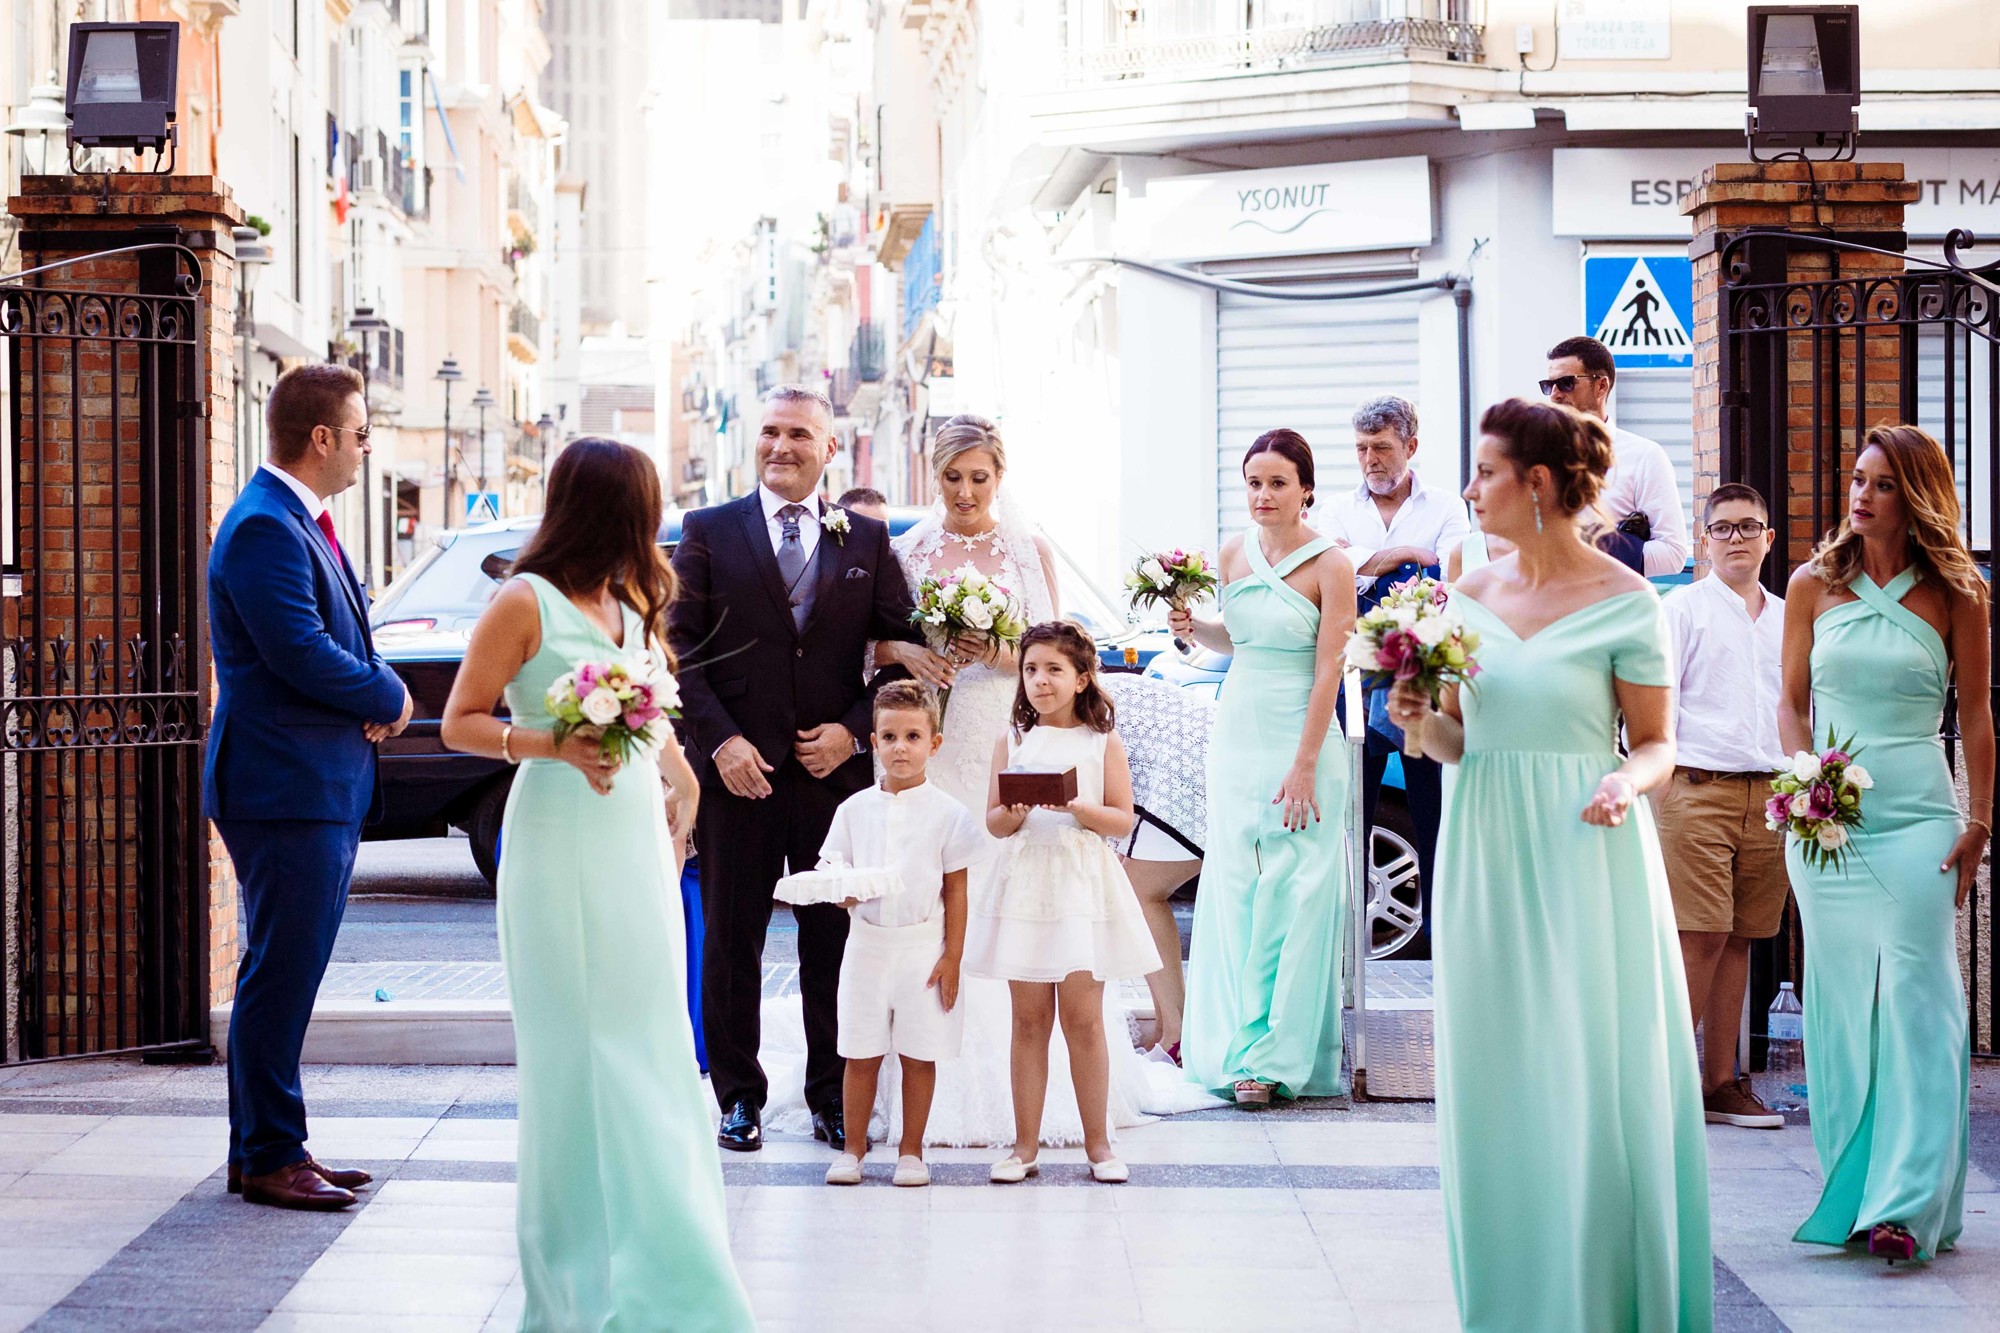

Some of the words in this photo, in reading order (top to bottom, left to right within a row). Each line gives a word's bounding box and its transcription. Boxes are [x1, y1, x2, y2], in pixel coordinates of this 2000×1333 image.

[1584, 20, 1625, 33] PLAZA
[1631, 20, 1647, 33] DE
[1576, 37, 1617, 50] TOROS
[1623, 37, 1656, 50] VIEJA
[1237, 183, 1331, 211] YSONUT
